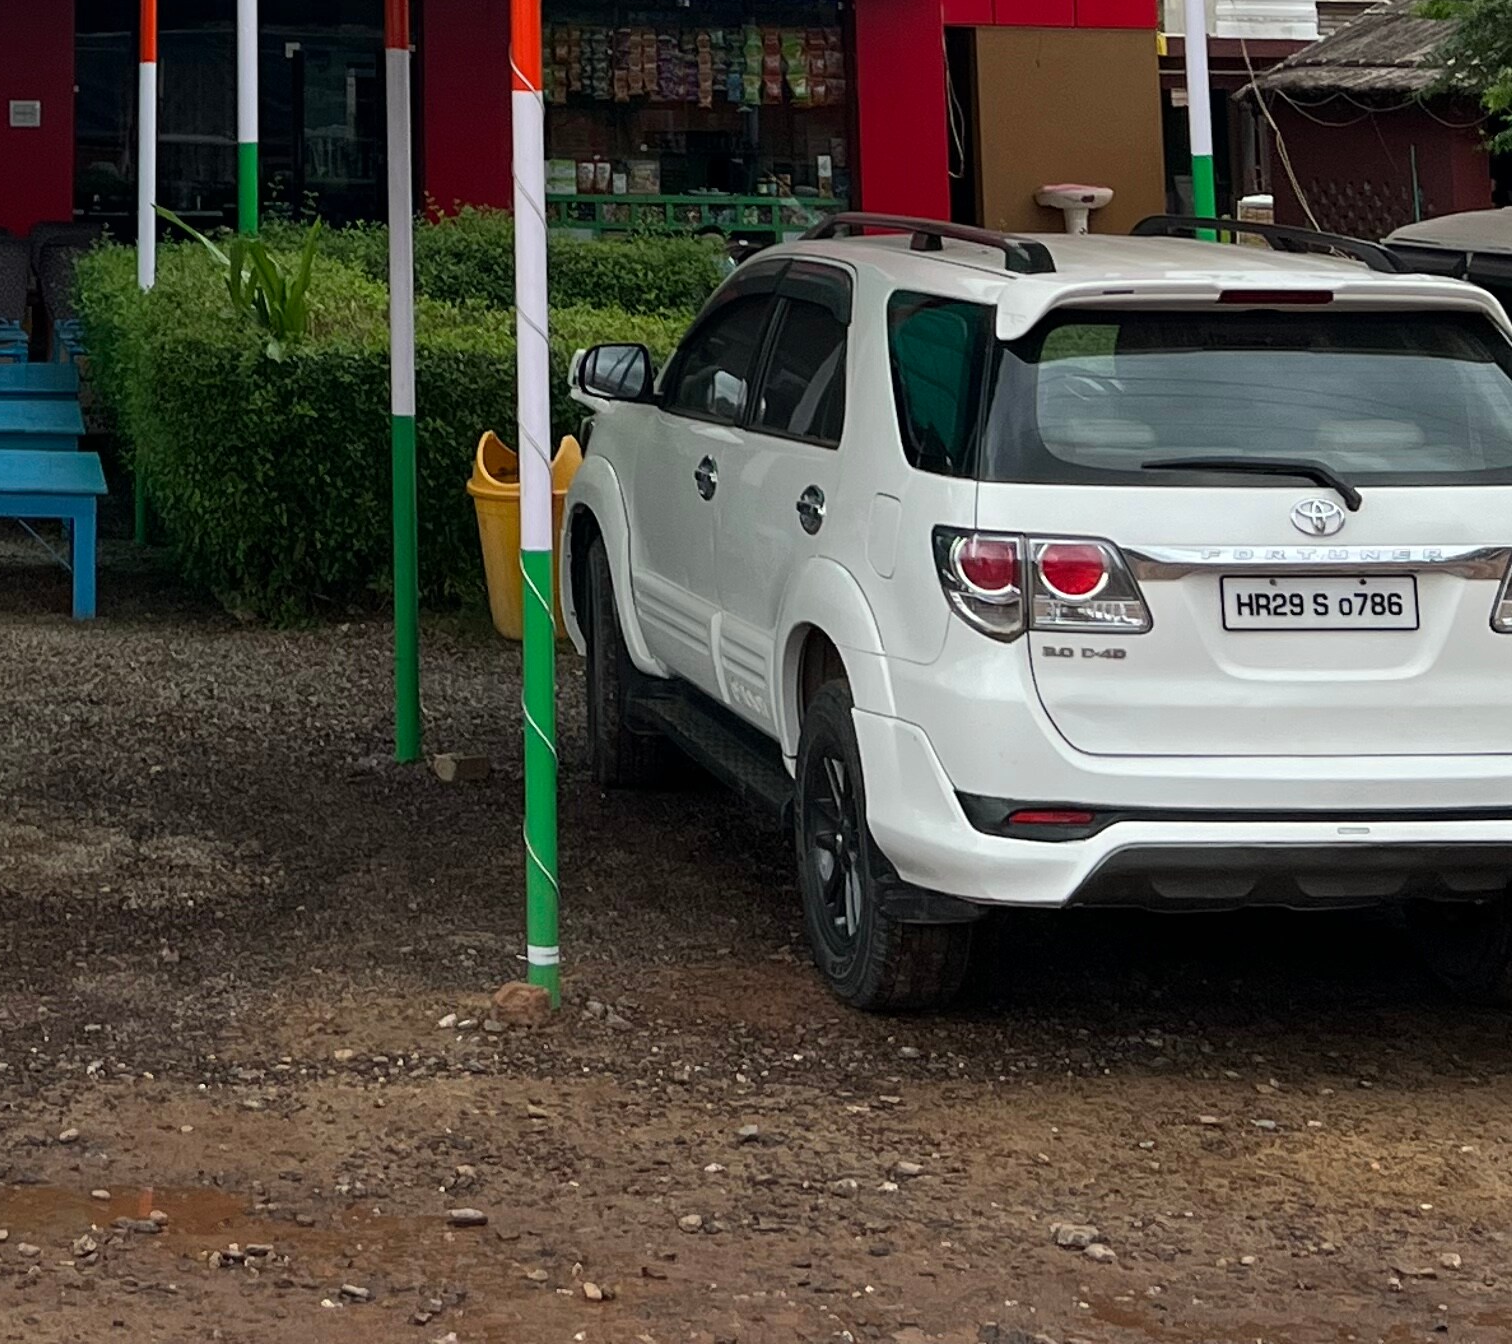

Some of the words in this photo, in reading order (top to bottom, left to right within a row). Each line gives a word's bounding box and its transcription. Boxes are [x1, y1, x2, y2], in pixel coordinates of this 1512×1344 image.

[1199, 548, 1444, 562] FORTUNER
[1236, 592, 1305, 617] HR29
[1312, 592, 1329, 617] S
